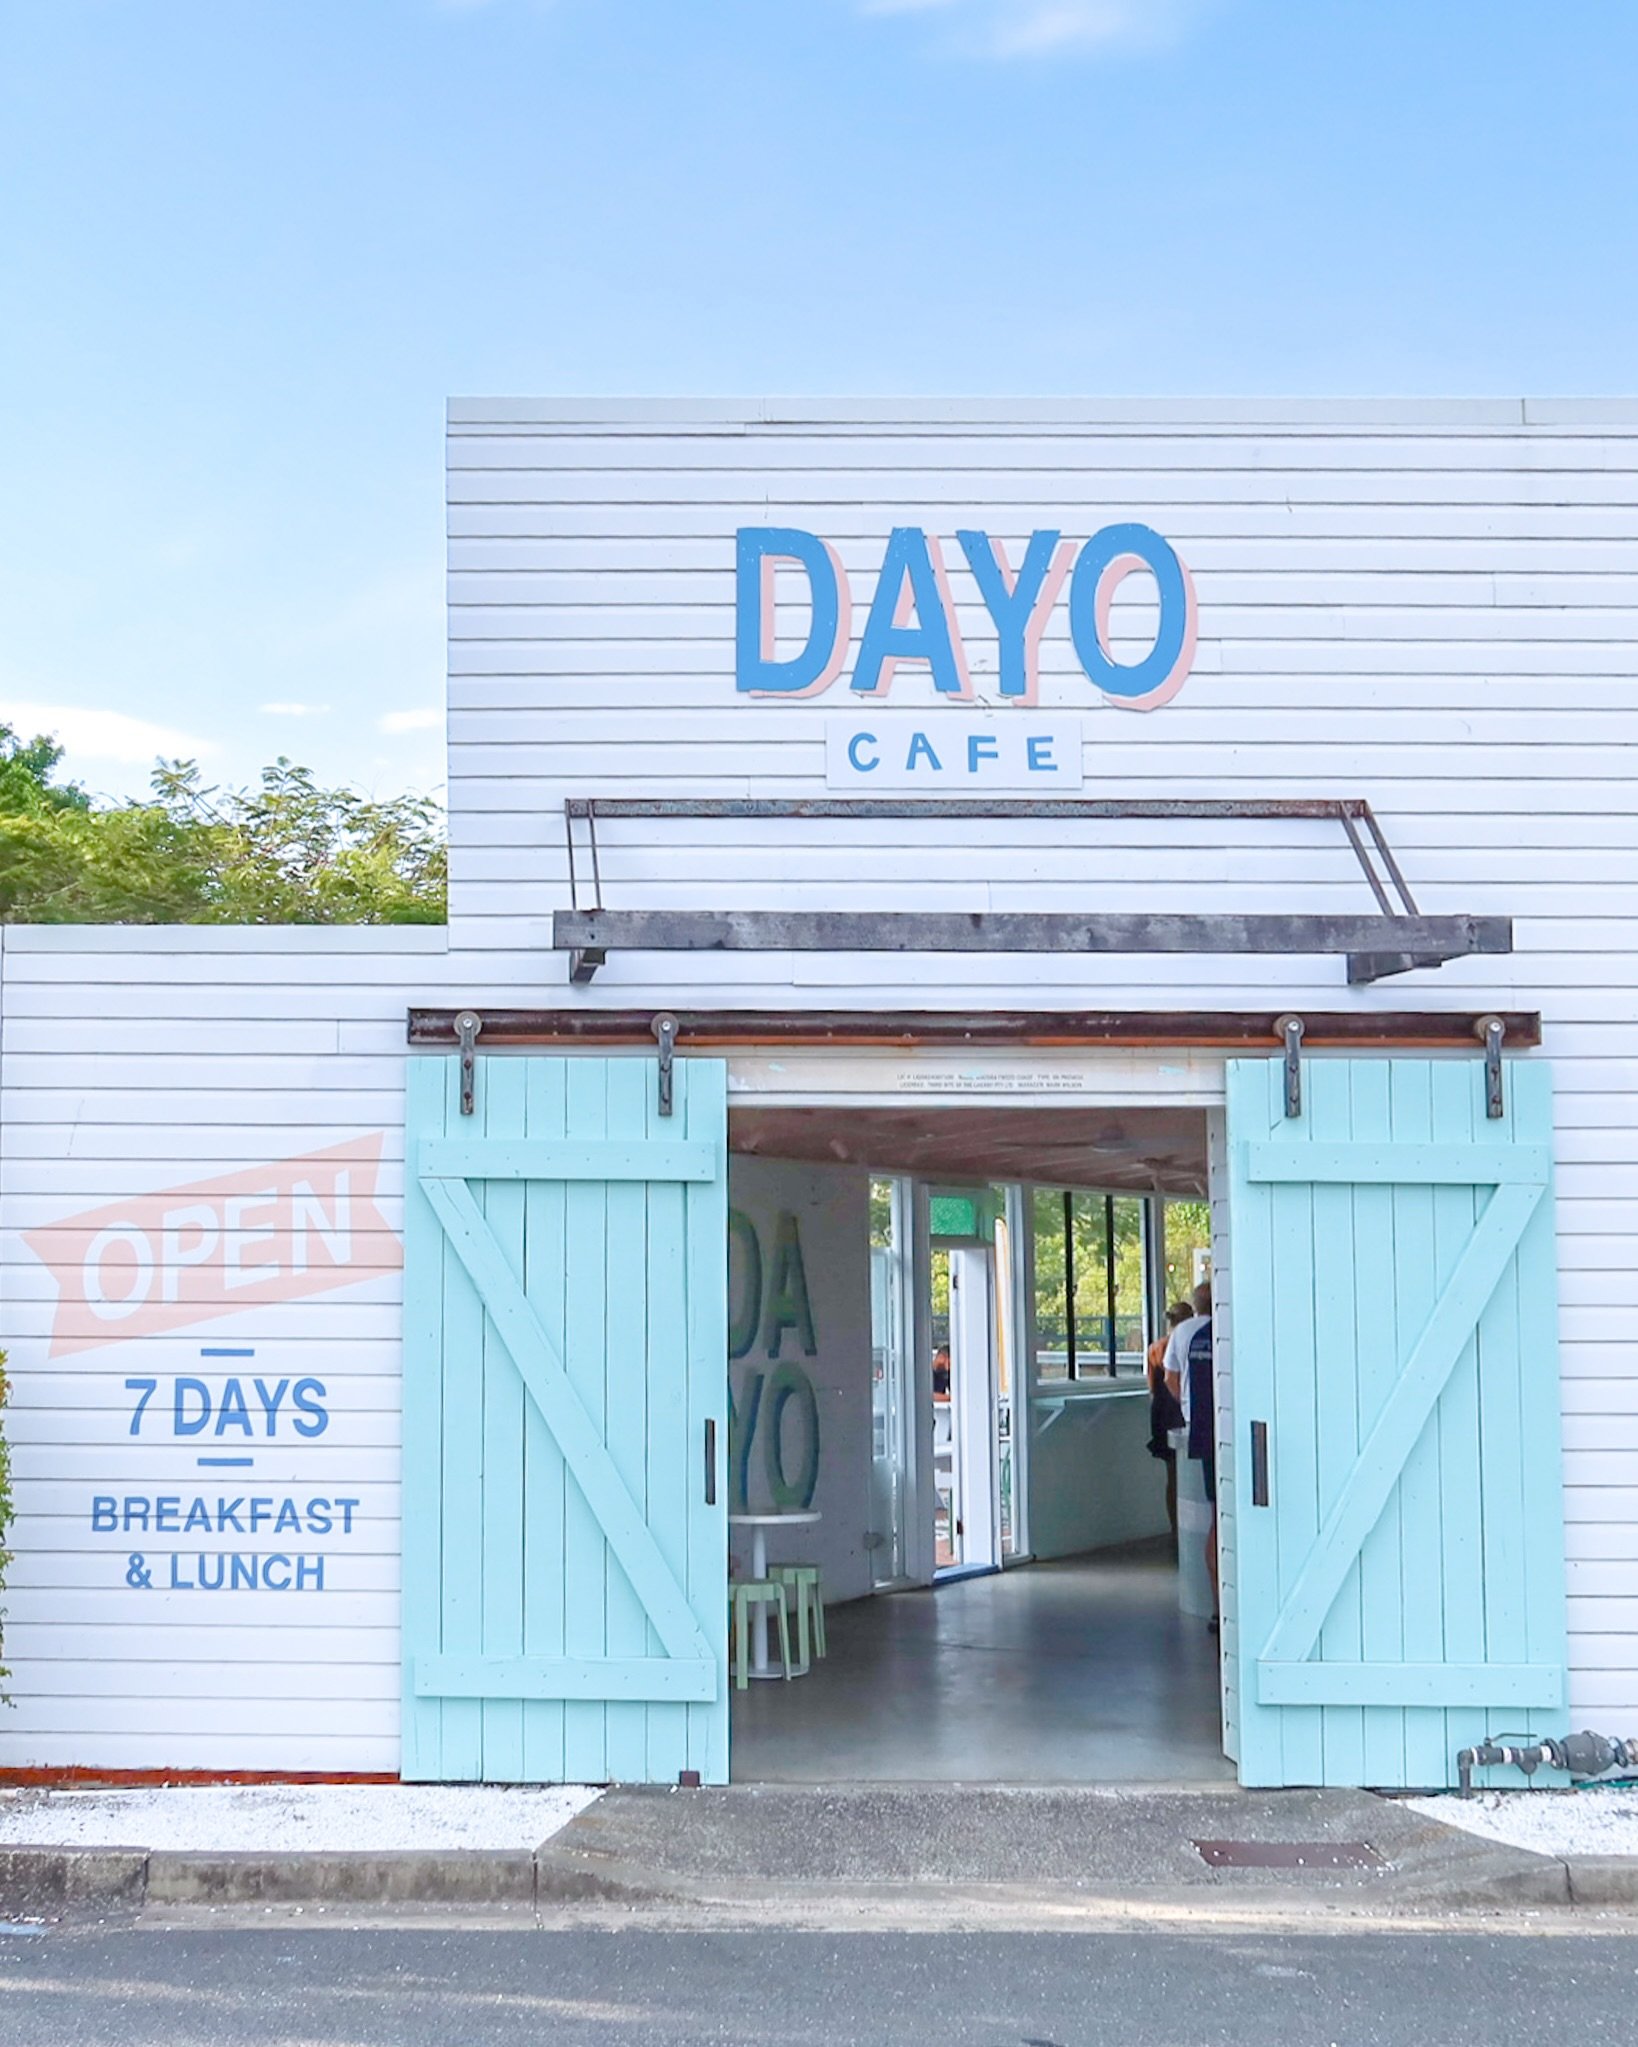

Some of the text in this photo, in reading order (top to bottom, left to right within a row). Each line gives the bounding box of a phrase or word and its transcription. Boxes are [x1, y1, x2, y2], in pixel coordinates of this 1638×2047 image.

[736, 523, 1198, 712] DAYO
[848, 732, 1058, 772] CAFE
[83, 1167, 352, 1320] OPEN
[124, 1377, 329, 1438] 7 DAYS
[91, 1495, 361, 1535] BREAKFAST
[125, 1551, 325, 1591] & LUNCH
